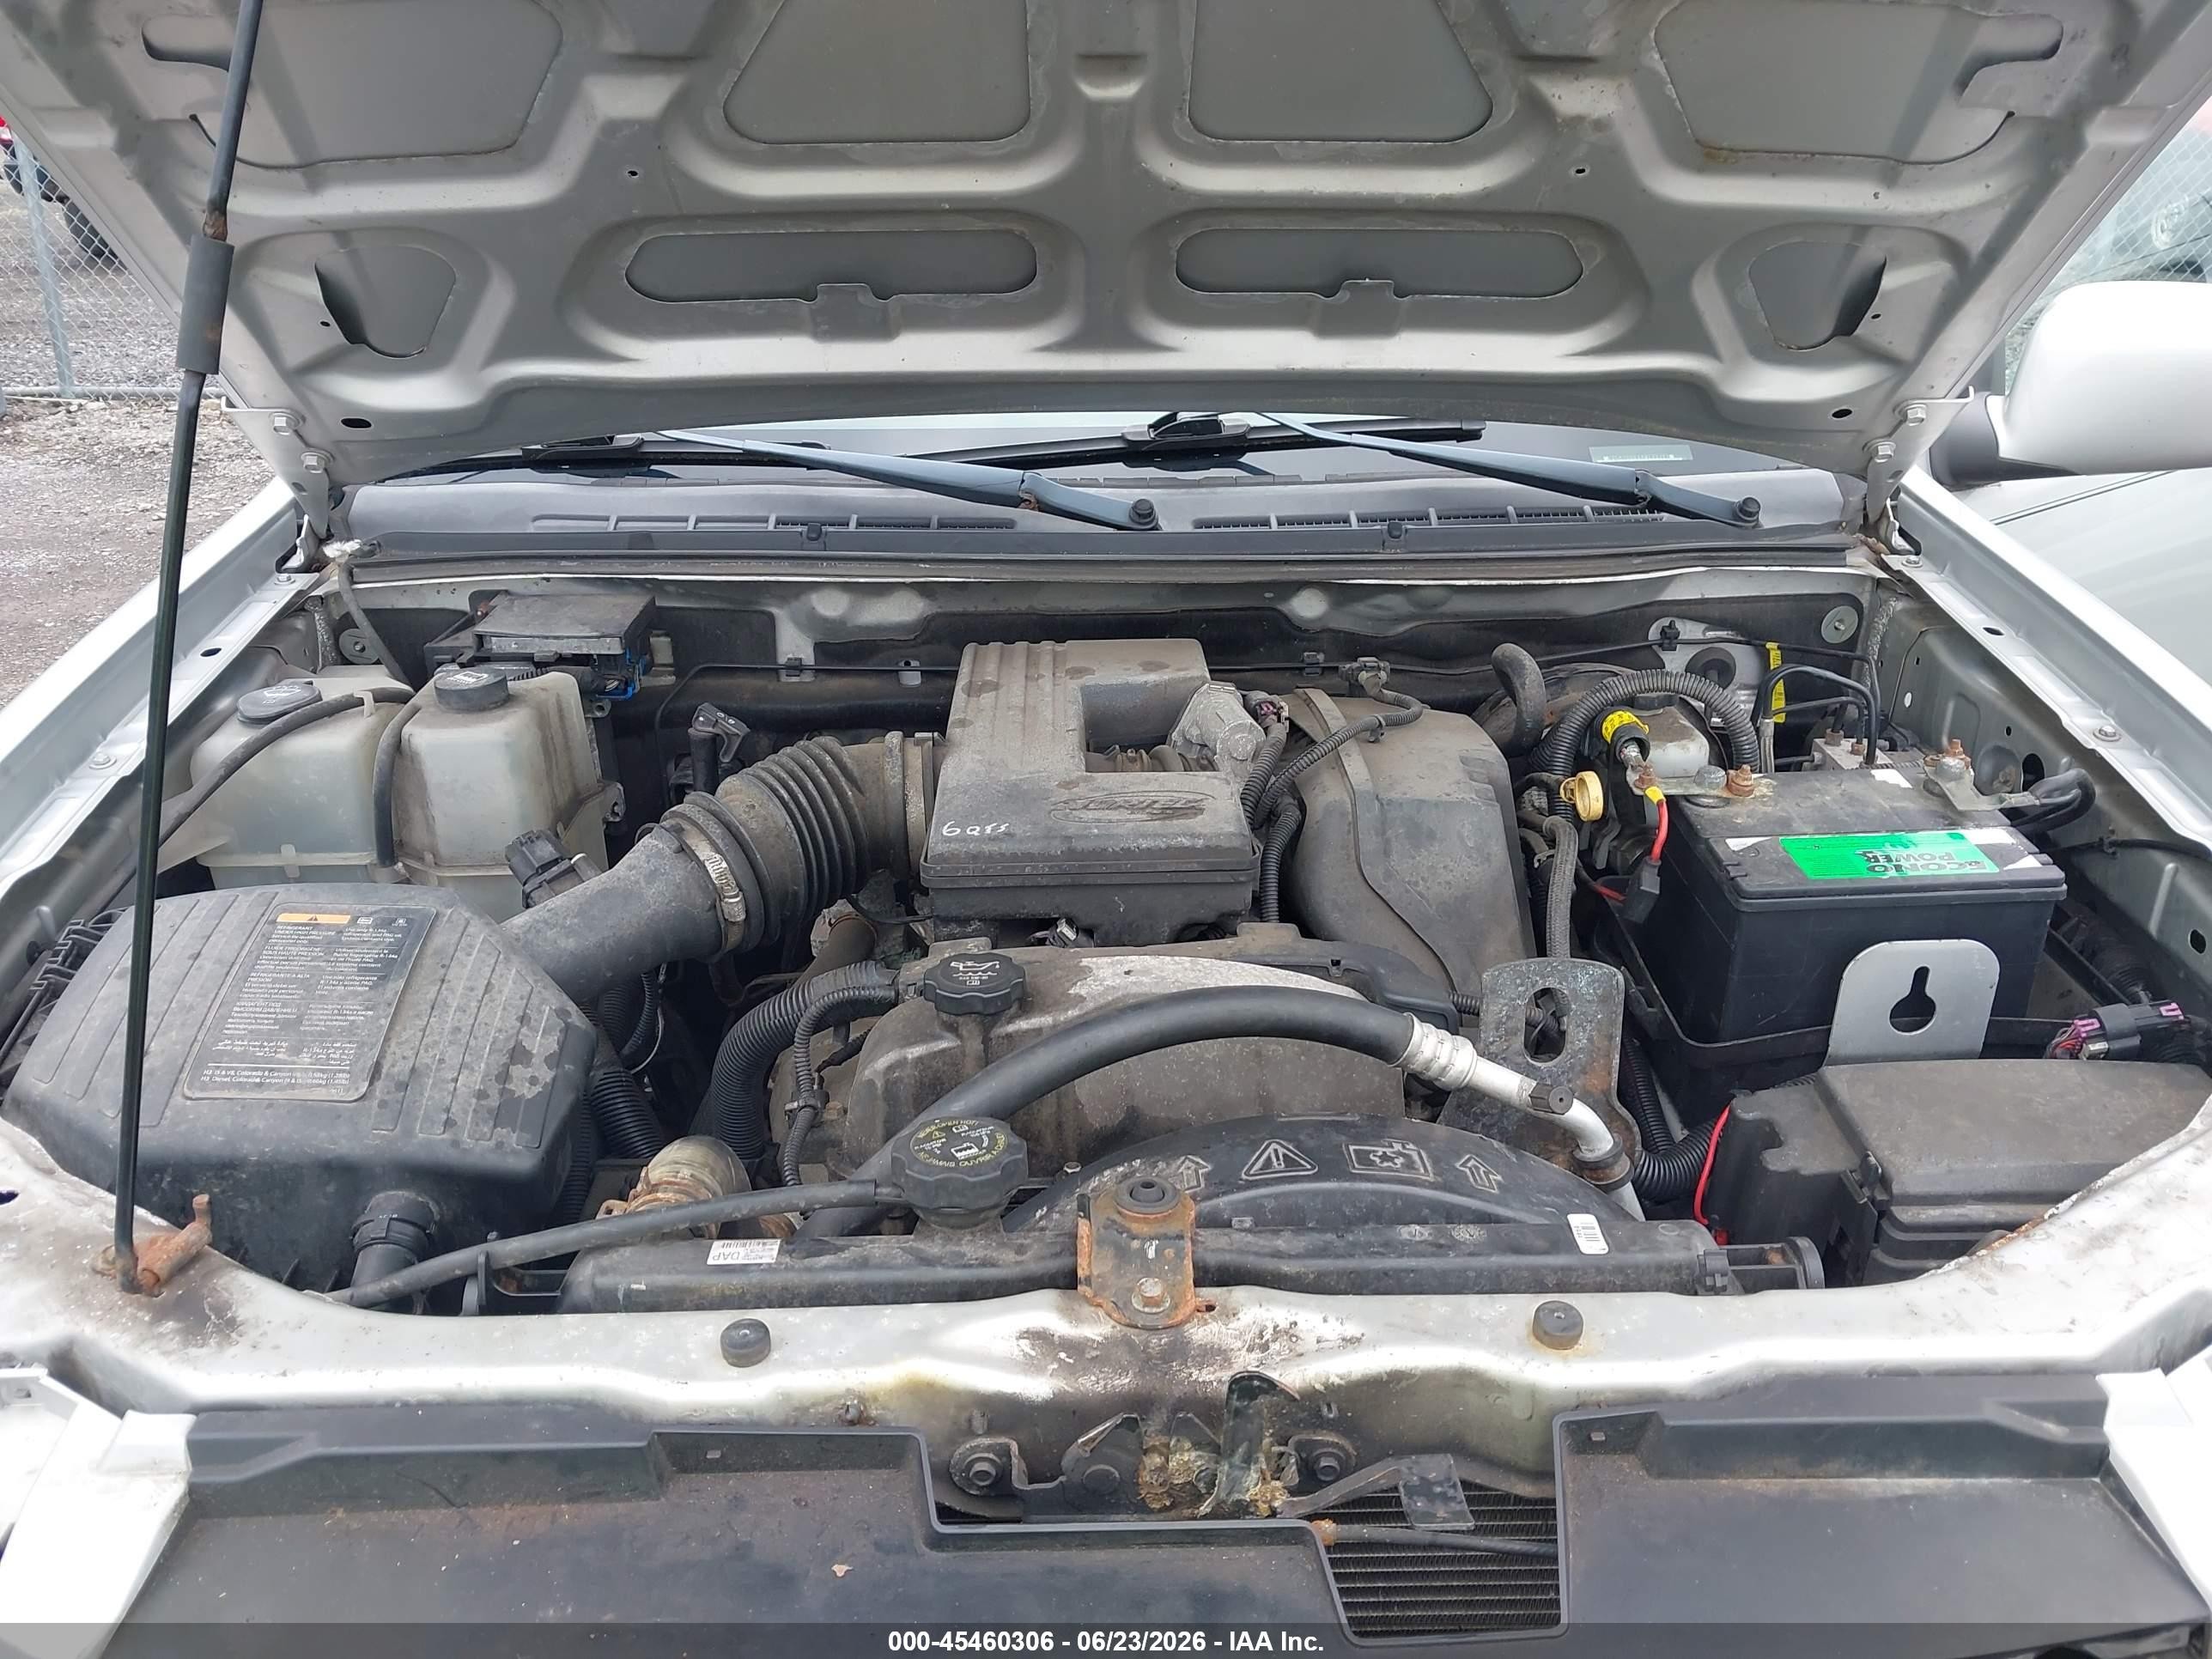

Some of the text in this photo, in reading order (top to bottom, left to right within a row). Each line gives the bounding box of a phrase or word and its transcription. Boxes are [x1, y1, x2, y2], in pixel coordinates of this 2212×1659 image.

[942, 821, 962, 836] 6
[1859, 851, 1954, 864] POWER
[713, 1251, 741, 1262] DAP
